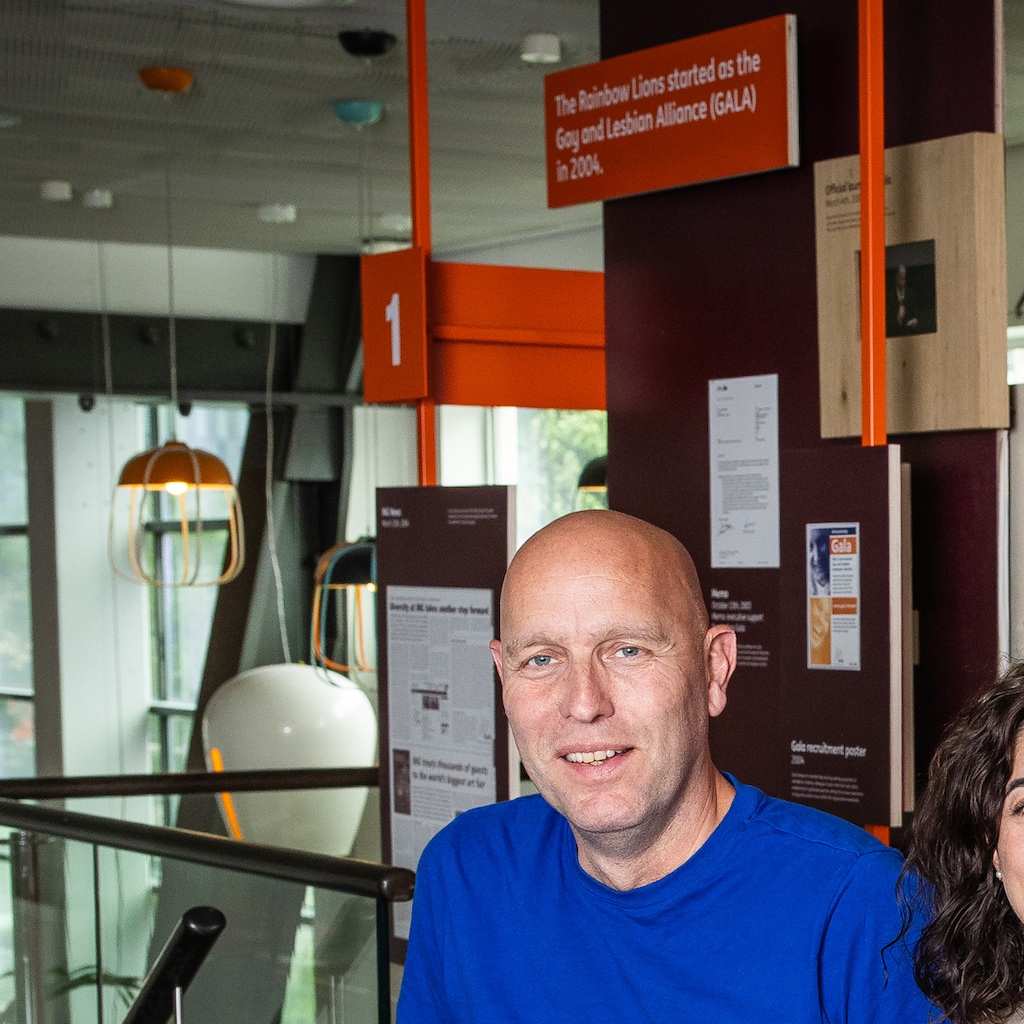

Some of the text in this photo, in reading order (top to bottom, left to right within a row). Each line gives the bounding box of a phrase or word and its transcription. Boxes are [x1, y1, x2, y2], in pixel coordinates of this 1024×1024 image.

[554, 49, 760, 117] The Rainbow Lions started as the
[556, 84, 756, 153] Gay and Lesbian Alliance (GALA)
[556, 153, 604, 182] in 2004.
[386, 293, 400, 366] 1
[832, 539, 852, 553] Gala
[791, 740, 867, 758] Gala recruitment poster
